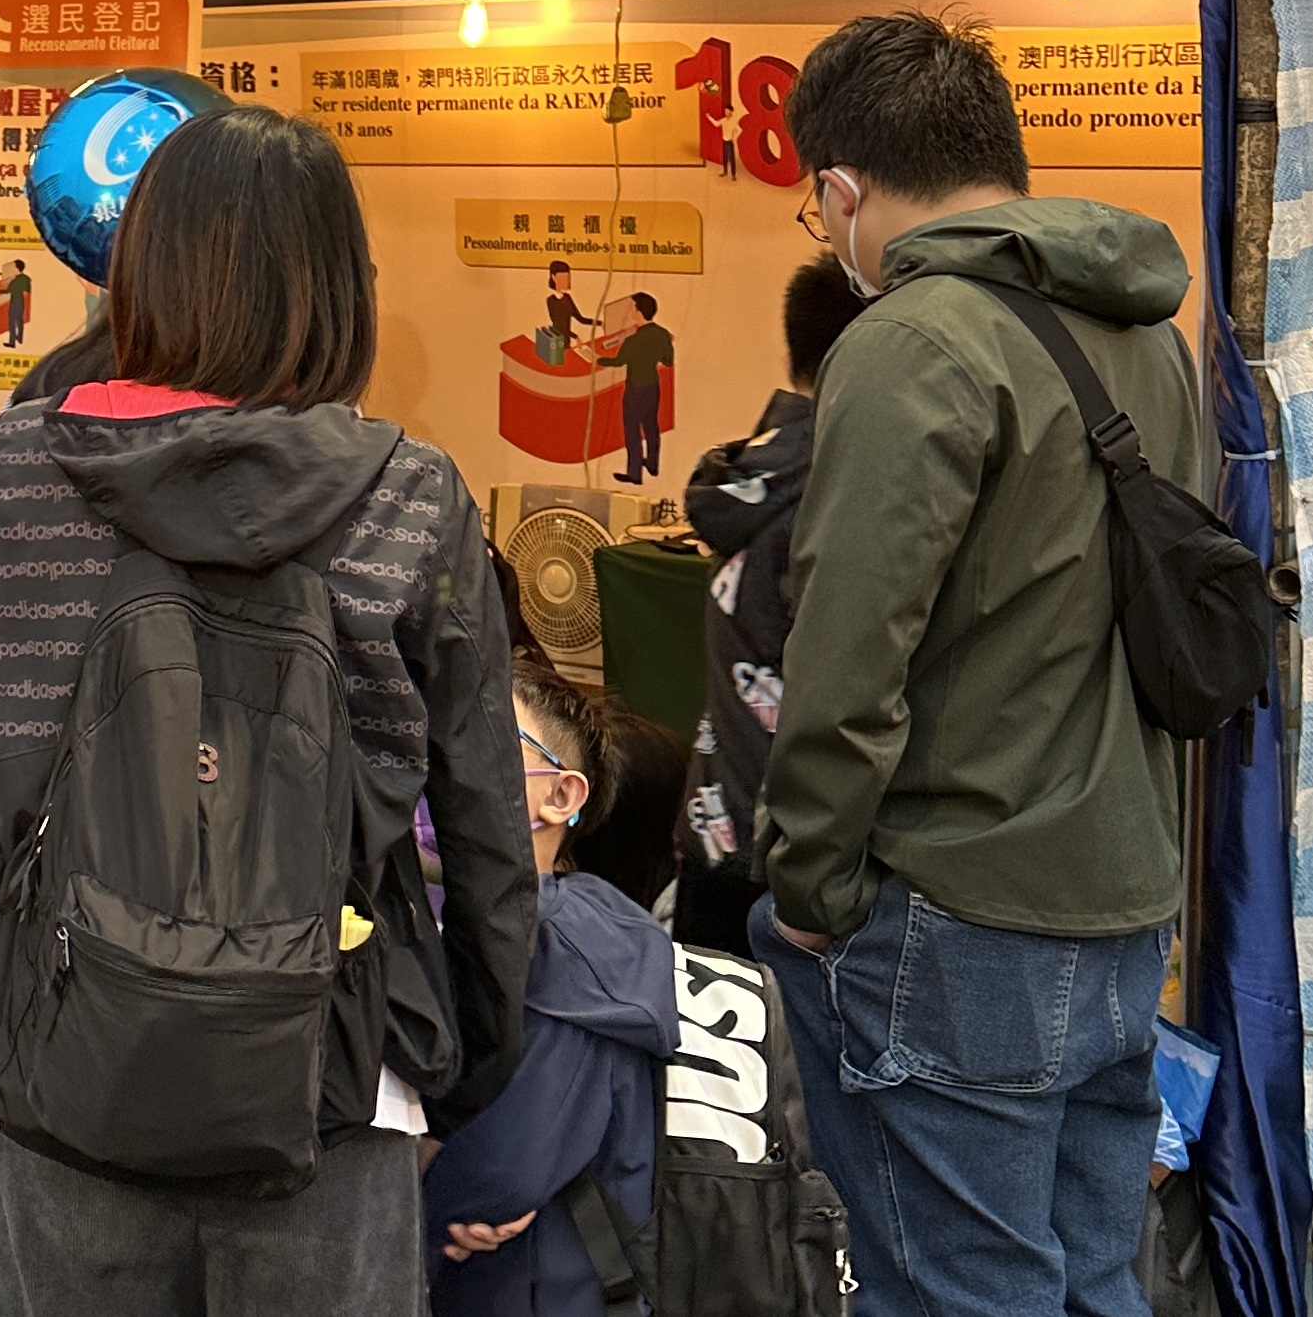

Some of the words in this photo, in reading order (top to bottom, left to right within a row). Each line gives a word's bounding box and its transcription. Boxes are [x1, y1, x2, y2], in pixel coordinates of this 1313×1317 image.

[21, 1, 160, 34] 選民登記
[20, 36, 106, 52] Recenseamento
[109, 35, 159, 51] Eleitoral
[1015, 78, 1148, 101] permanente
[1155, 76, 1183, 95] da
[312, 96, 338, 114] Ser
[342, 93, 412, 113] residente
[416, 91, 514, 115] permanente
[519, 93, 539, 110] da
[545, 93, 606, 110] RAEM
[628, 93, 667, 109] aior
[675, 37, 810, 188] 18
[1017, 108, 1082, 127] dendo
[338, 122, 354, 138] 18
[357, 123, 393, 138] anos
[463, 235, 543, 253] Pessoalmente,
[618, 243, 626, 254] a
[629, 242, 649, 254] um
[652, 240, 693, 255] balcão
[3, 520, 55, 541] adidas
[5, 600, 58, 620] adidas
[8, 679, 59, 700] adidas
